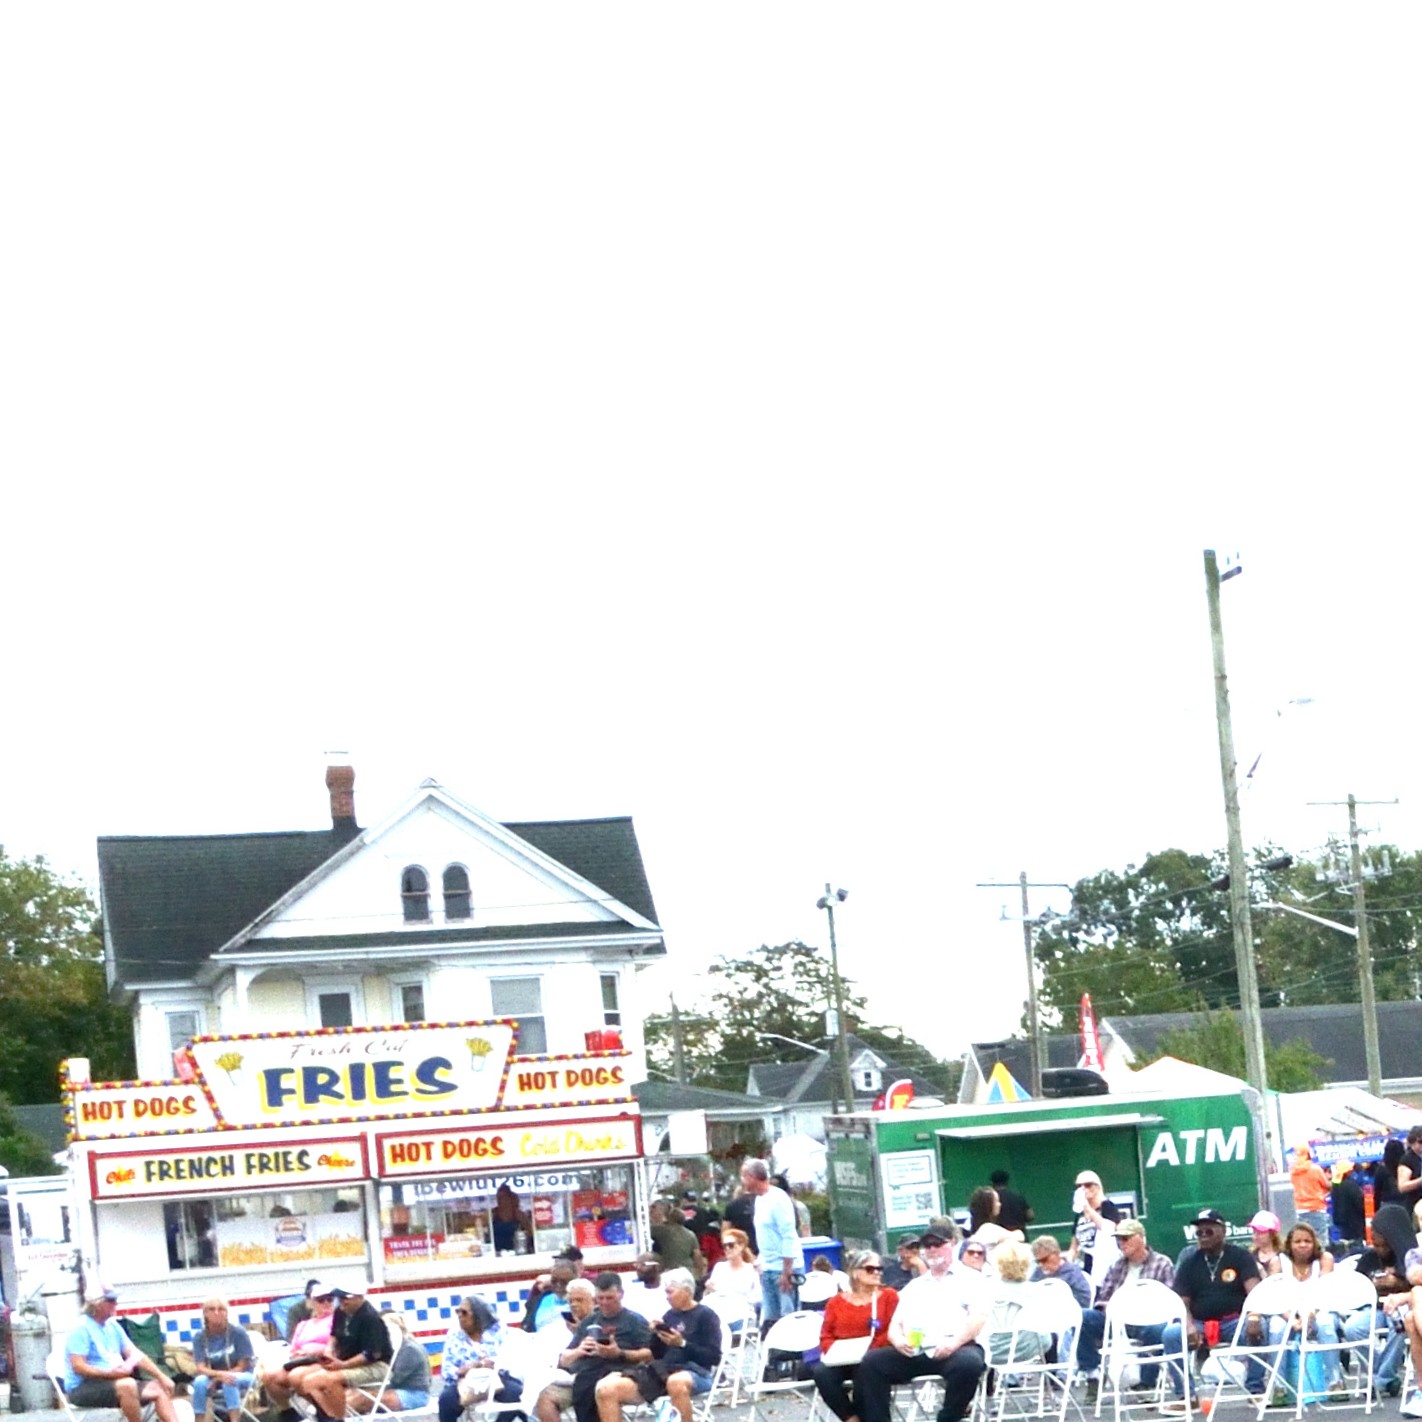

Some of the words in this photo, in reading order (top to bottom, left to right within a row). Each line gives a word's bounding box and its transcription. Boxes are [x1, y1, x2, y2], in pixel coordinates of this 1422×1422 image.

[262, 1056, 459, 1110] FRIES
[518, 1071, 559, 1092] HOT
[565, 1066, 625, 1088] DOGS
[82, 1101, 127, 1122] HOT
[134, 1095, 197, 1119] DOGS
[390, 1141, 435, 1164] HOT
[441, 1136, 505, 1160] DOGS
[1146, 1126, 1248, 1168] ATM
[144, 1154, 235, 1182] FRENCH
[245, 1150, 312, 1175] FRIES
